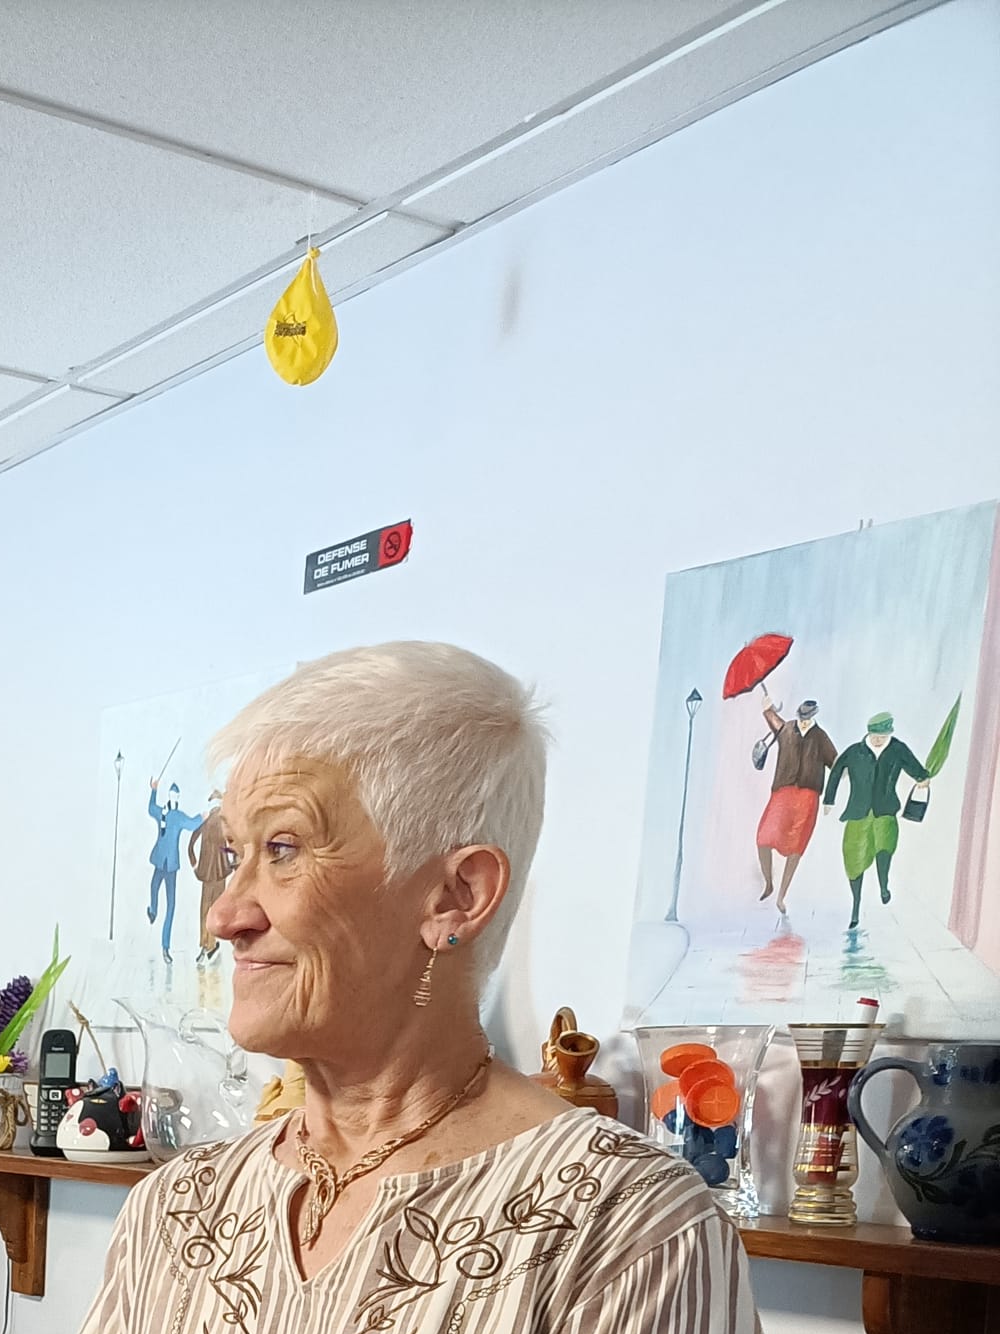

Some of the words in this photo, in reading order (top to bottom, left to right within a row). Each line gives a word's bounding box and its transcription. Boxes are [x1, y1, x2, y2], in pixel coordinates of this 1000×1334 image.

[317, 539, 367, 565] DEFENSE
[313, 566, 329, 580] DE
[330, 552, 370, 574] FUMER
